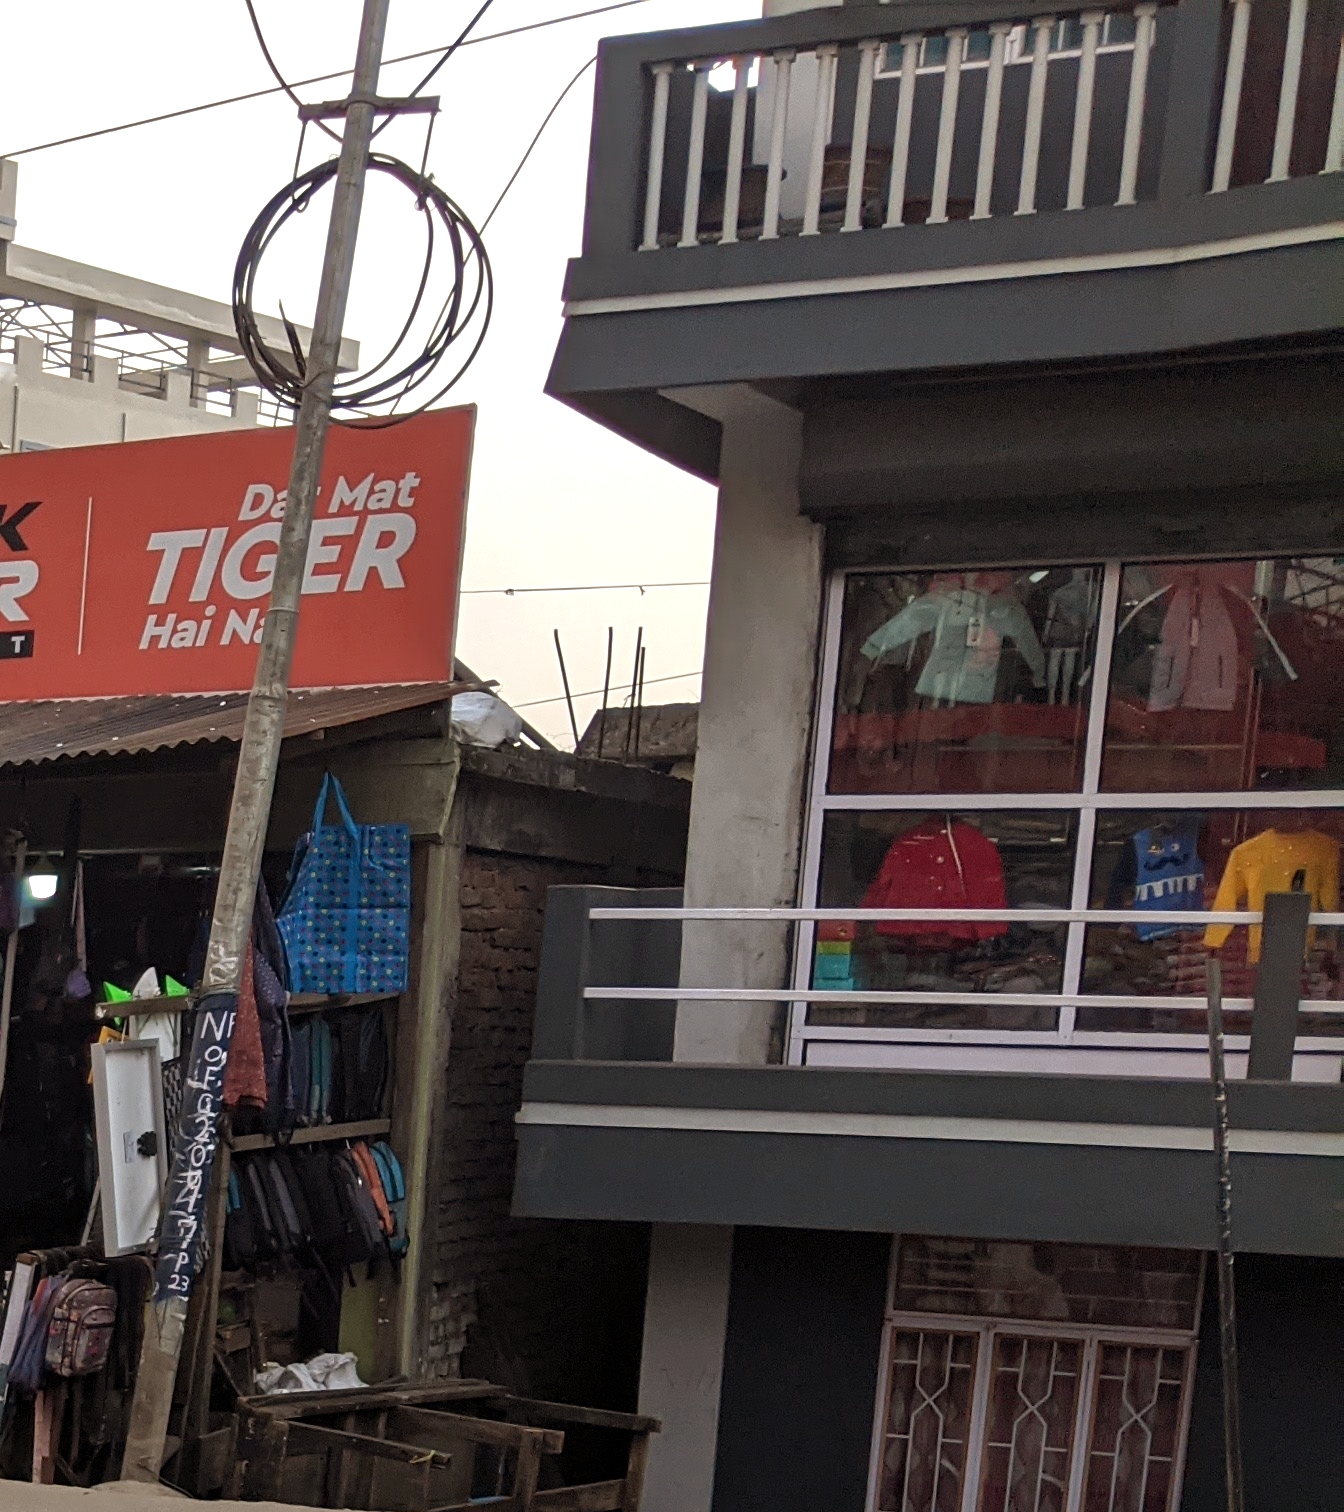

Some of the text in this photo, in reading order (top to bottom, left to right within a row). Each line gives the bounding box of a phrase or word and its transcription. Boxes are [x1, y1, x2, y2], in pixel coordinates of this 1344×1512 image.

[238, 471, 421, 522] Da Mat
[146, 511, 417, 605] TIGER
[139, 605, 217, 651] Hai
